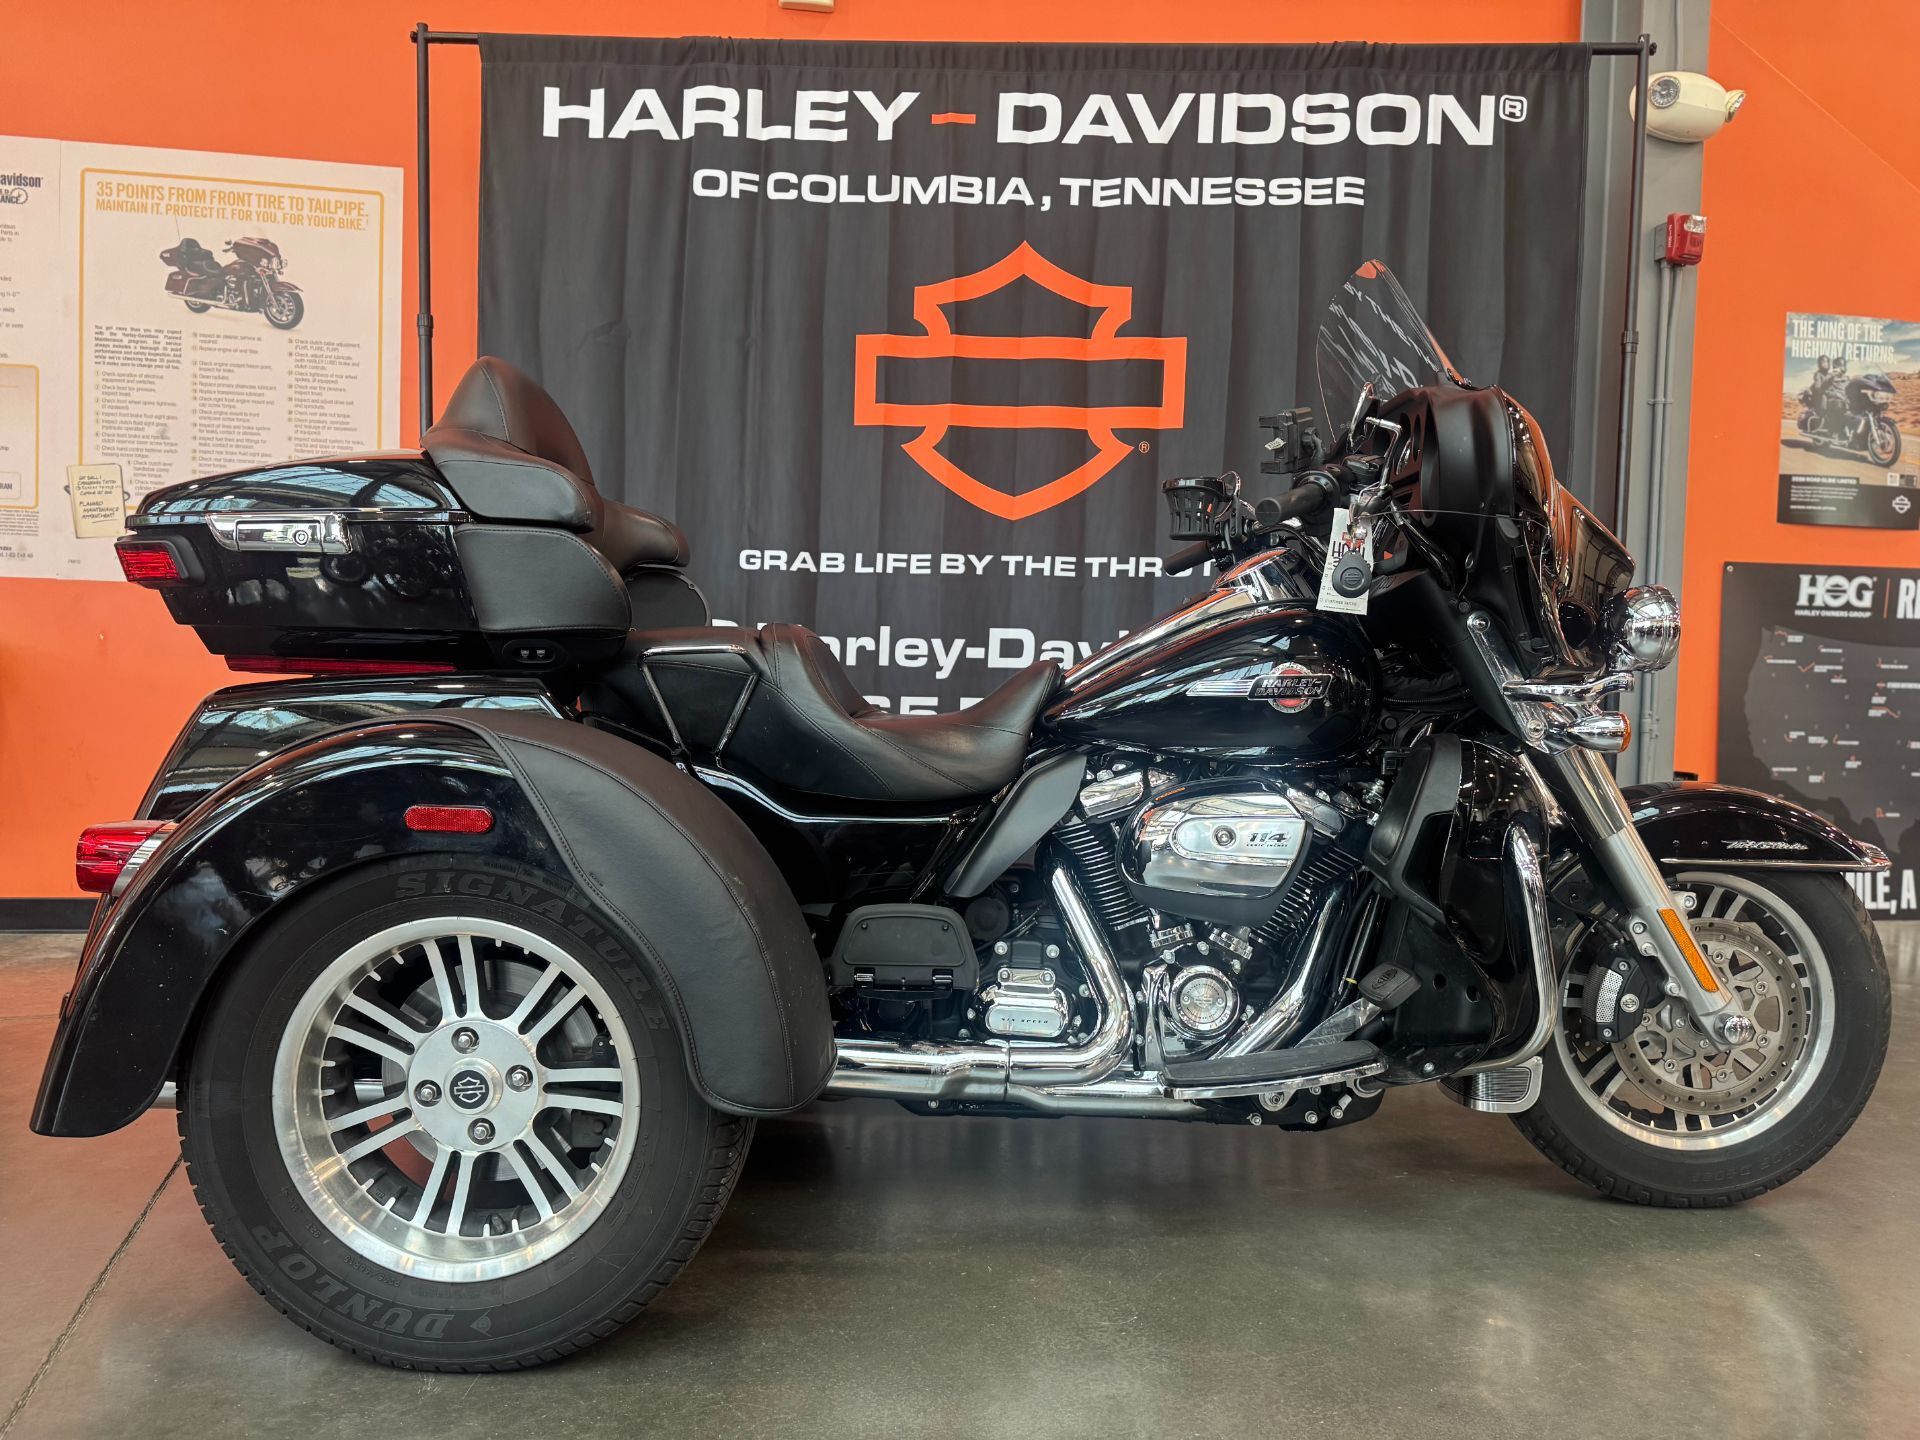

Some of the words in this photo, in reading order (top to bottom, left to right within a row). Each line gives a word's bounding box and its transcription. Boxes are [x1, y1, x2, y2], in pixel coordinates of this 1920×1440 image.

[543, 85, 920, 141] HARLEY
[96, 181, 113, 197] 35
[116, 182, 164, 201] POINTS
[168, 187, 208, 204] FROM
[209, 190, 253, 207] FRONT
[256, 193, 285, 210] TIRE
[288, 196, 305, 211] TO
[307, 198, 369, 218] TAILPIPE.
[693, 169, 760, 199] OF
[766, 172, 1050, 212] COLUMBIA,
[1059, 176, 1365, 208] TENNESSEE
[96, 198, 148, 214] MAINTAIN
[151, 203, 163, 216] IT.
[165, 204, 214, 219] PROTECT
[216, 207, 229, 220] IT.
[230, 208, 252, 221] FOR
[255, 210, 279, 225] YOU.
[282, 213, 303, 226] FOR
[306, 214, 336, 229] YOUR
[1792, 320, 1815, 338] THE
[1817, 321, 1845, 341] KING
[1848, 323, 1861, 341] OF
[1863, 325, 1883, 343] THE
[1791, 340, 1844, 360] HIGHWAY
[1846, 343, 1896, 364] RETURNS.
[739, 549, 845, 574] GRAB
[854, 552, 932, 575] LIFE
[940, 554, 994, 576] BY
[1000, 554, 1077, 577] THE
[1796, 574, 1875, 609] HOG
[1795, 609, 1820, 617] HARLEY
[1821, 610, 1848, 618] OWNERS
[1849, 611, 1872, 619] GROUP
[1254, 687, 1323, 697] DAVIDSON
[1250, 832, 1288, 843] 114
[1901, 869, 1917, 909] A
[395, 871, 672, 1032] SIGNATURE
[251, 1225, 456, 1339] DUNLOP
